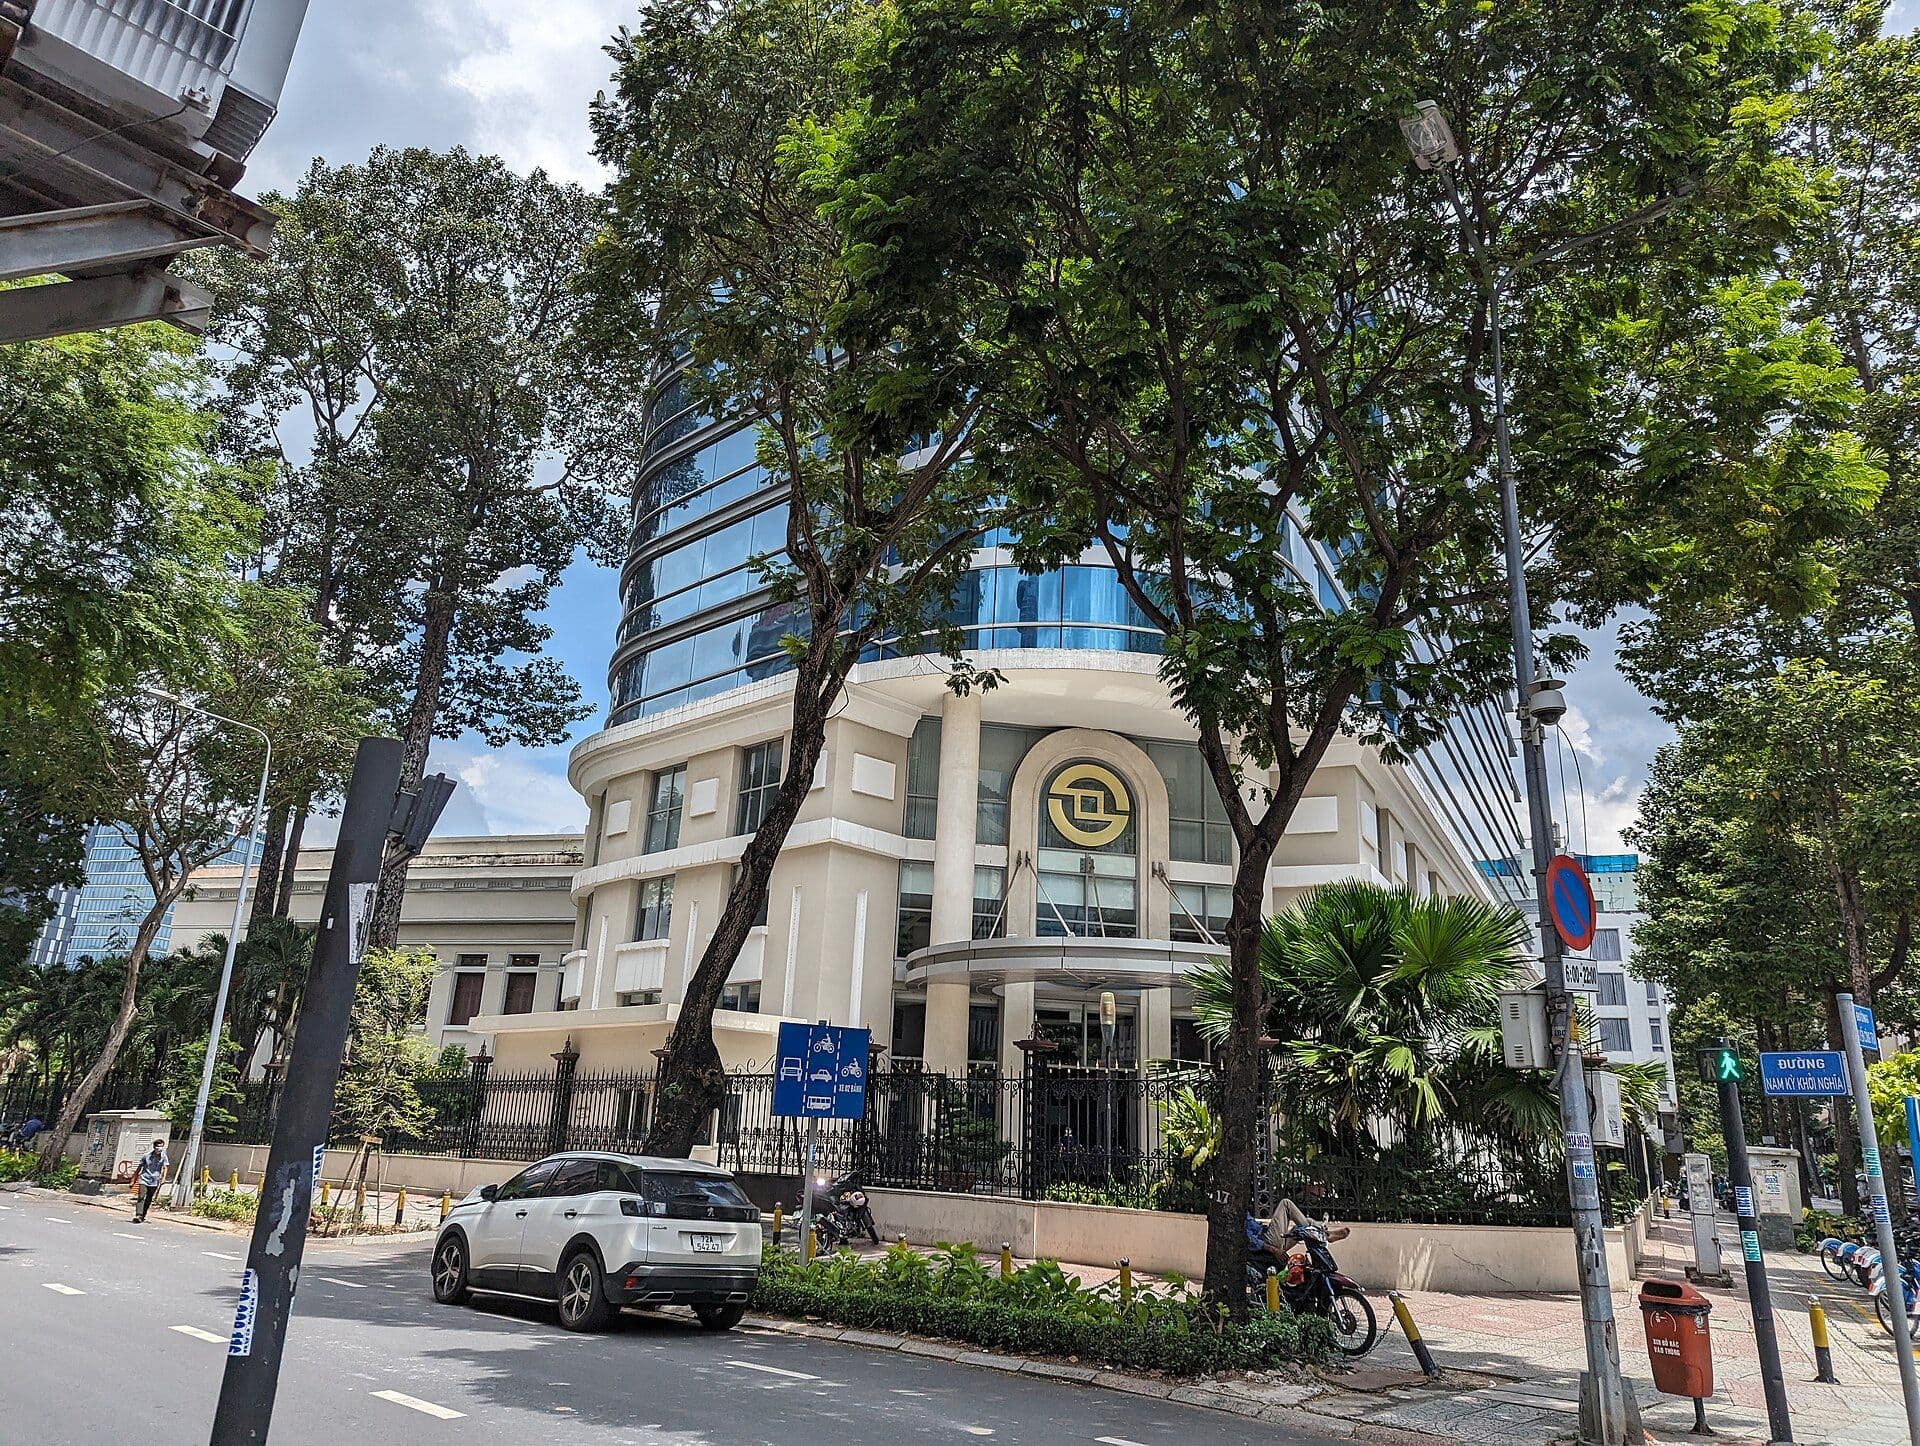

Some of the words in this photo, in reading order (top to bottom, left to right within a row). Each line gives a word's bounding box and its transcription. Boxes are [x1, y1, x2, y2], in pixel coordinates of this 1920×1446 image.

[1778, 1056, 1825, 1069] ĐƯỜNG
[1765, 1077, 1785, 1090] NAM
[1785, 1074, 1796, 1090] KỲ
[1797, 1072, 1817, 1090] KHỞI
[1817, 1074, 1844, 1090] NGHĨA
[1216, 1190, 1230, 1203] 17
[701, 1235, 713, 1243] 72A
